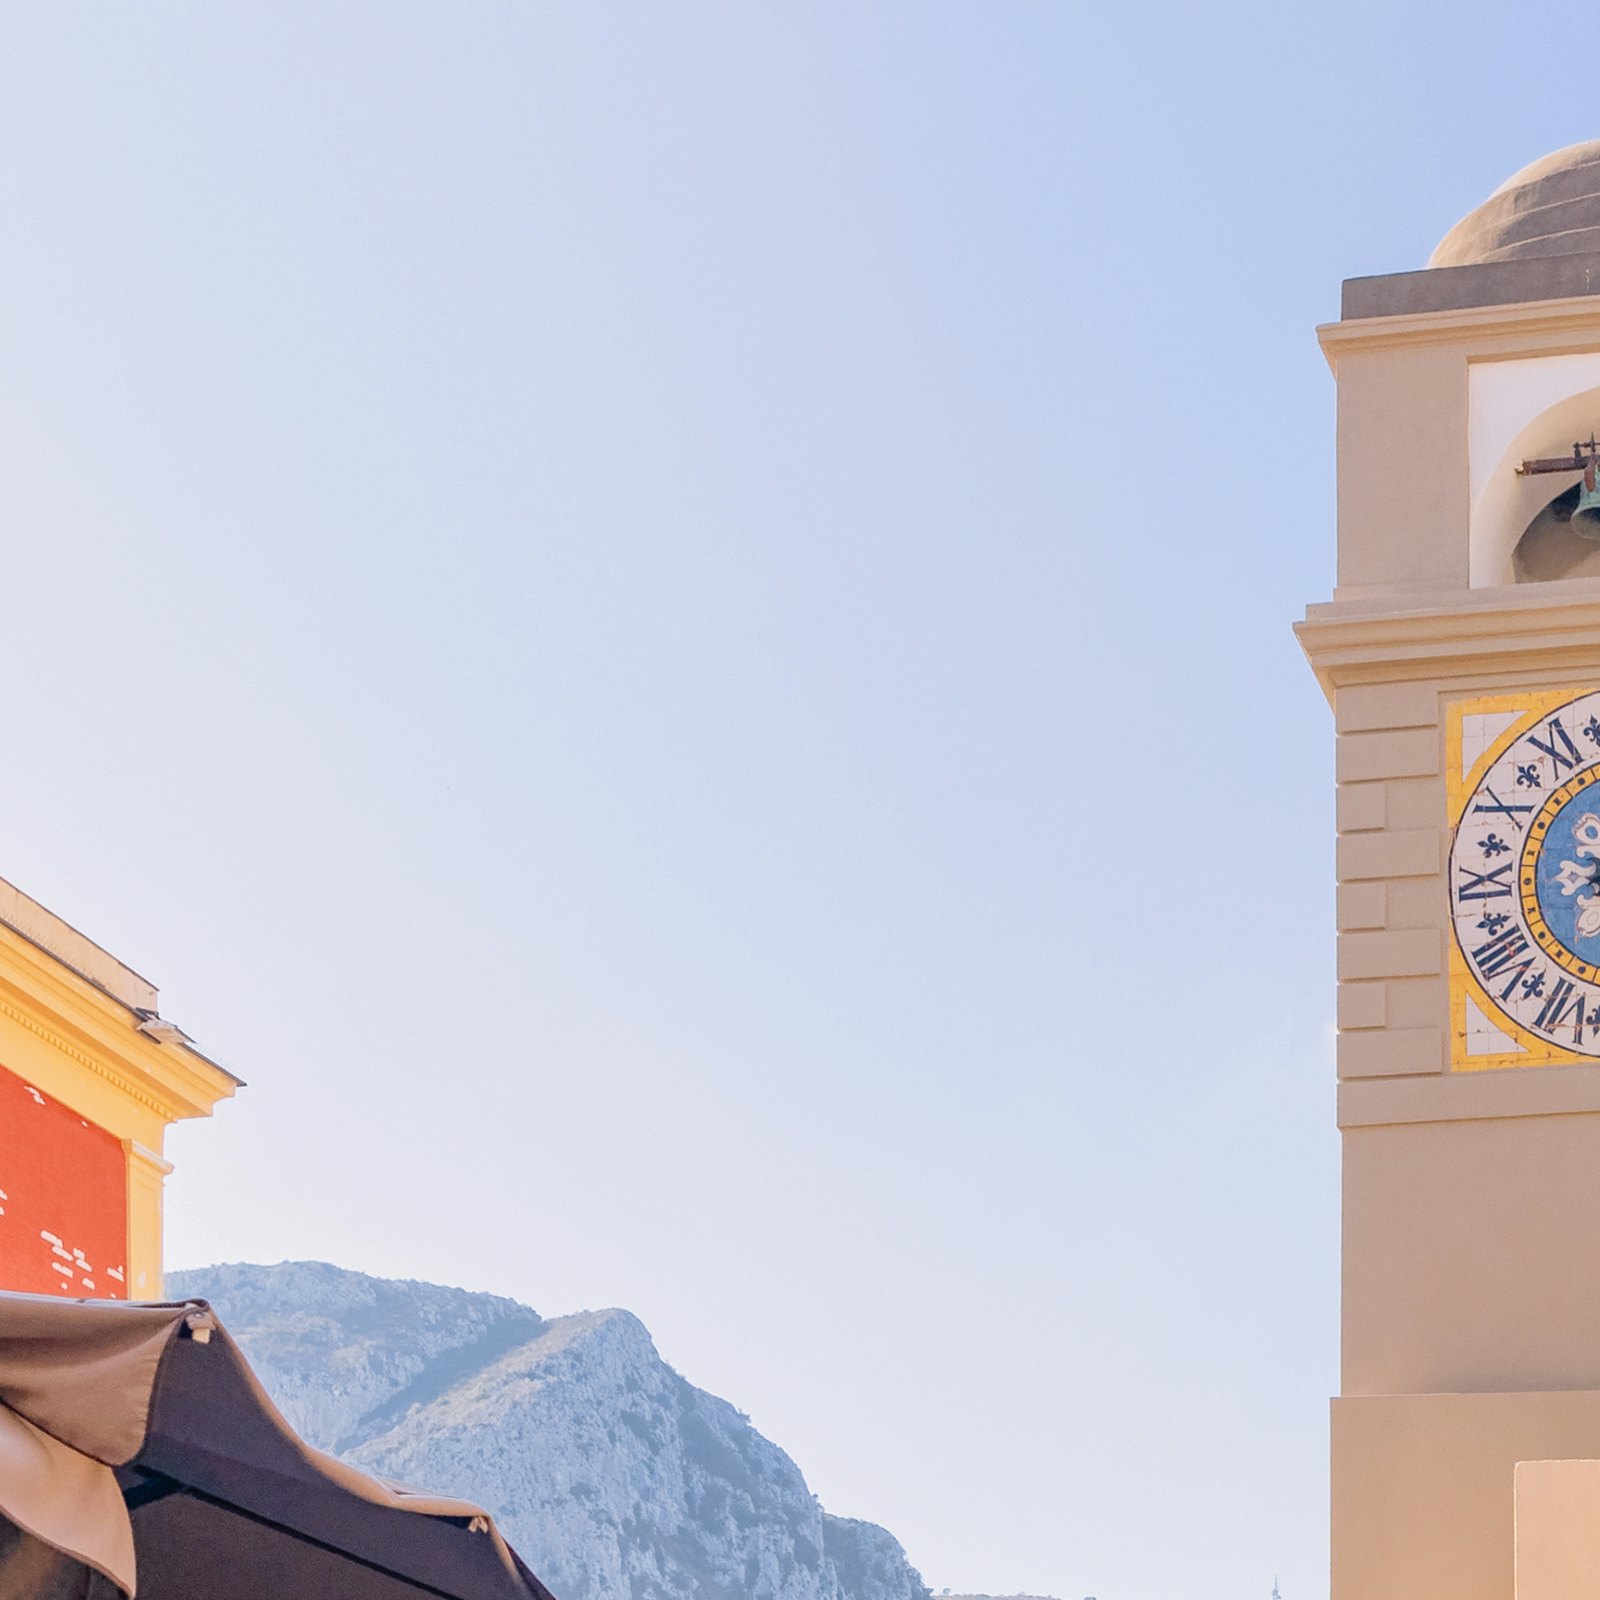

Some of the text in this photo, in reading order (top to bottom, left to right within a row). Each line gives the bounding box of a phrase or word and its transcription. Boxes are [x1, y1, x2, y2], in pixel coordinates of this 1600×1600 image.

[1525, 715, 1585, 782] XI
[1472, 786, 1537, 831] X
[1458, 861, 1514, 903] IX
[1471, 923, 1537, 1003] VIII
[1530, 977, 1586, 1045] VII
